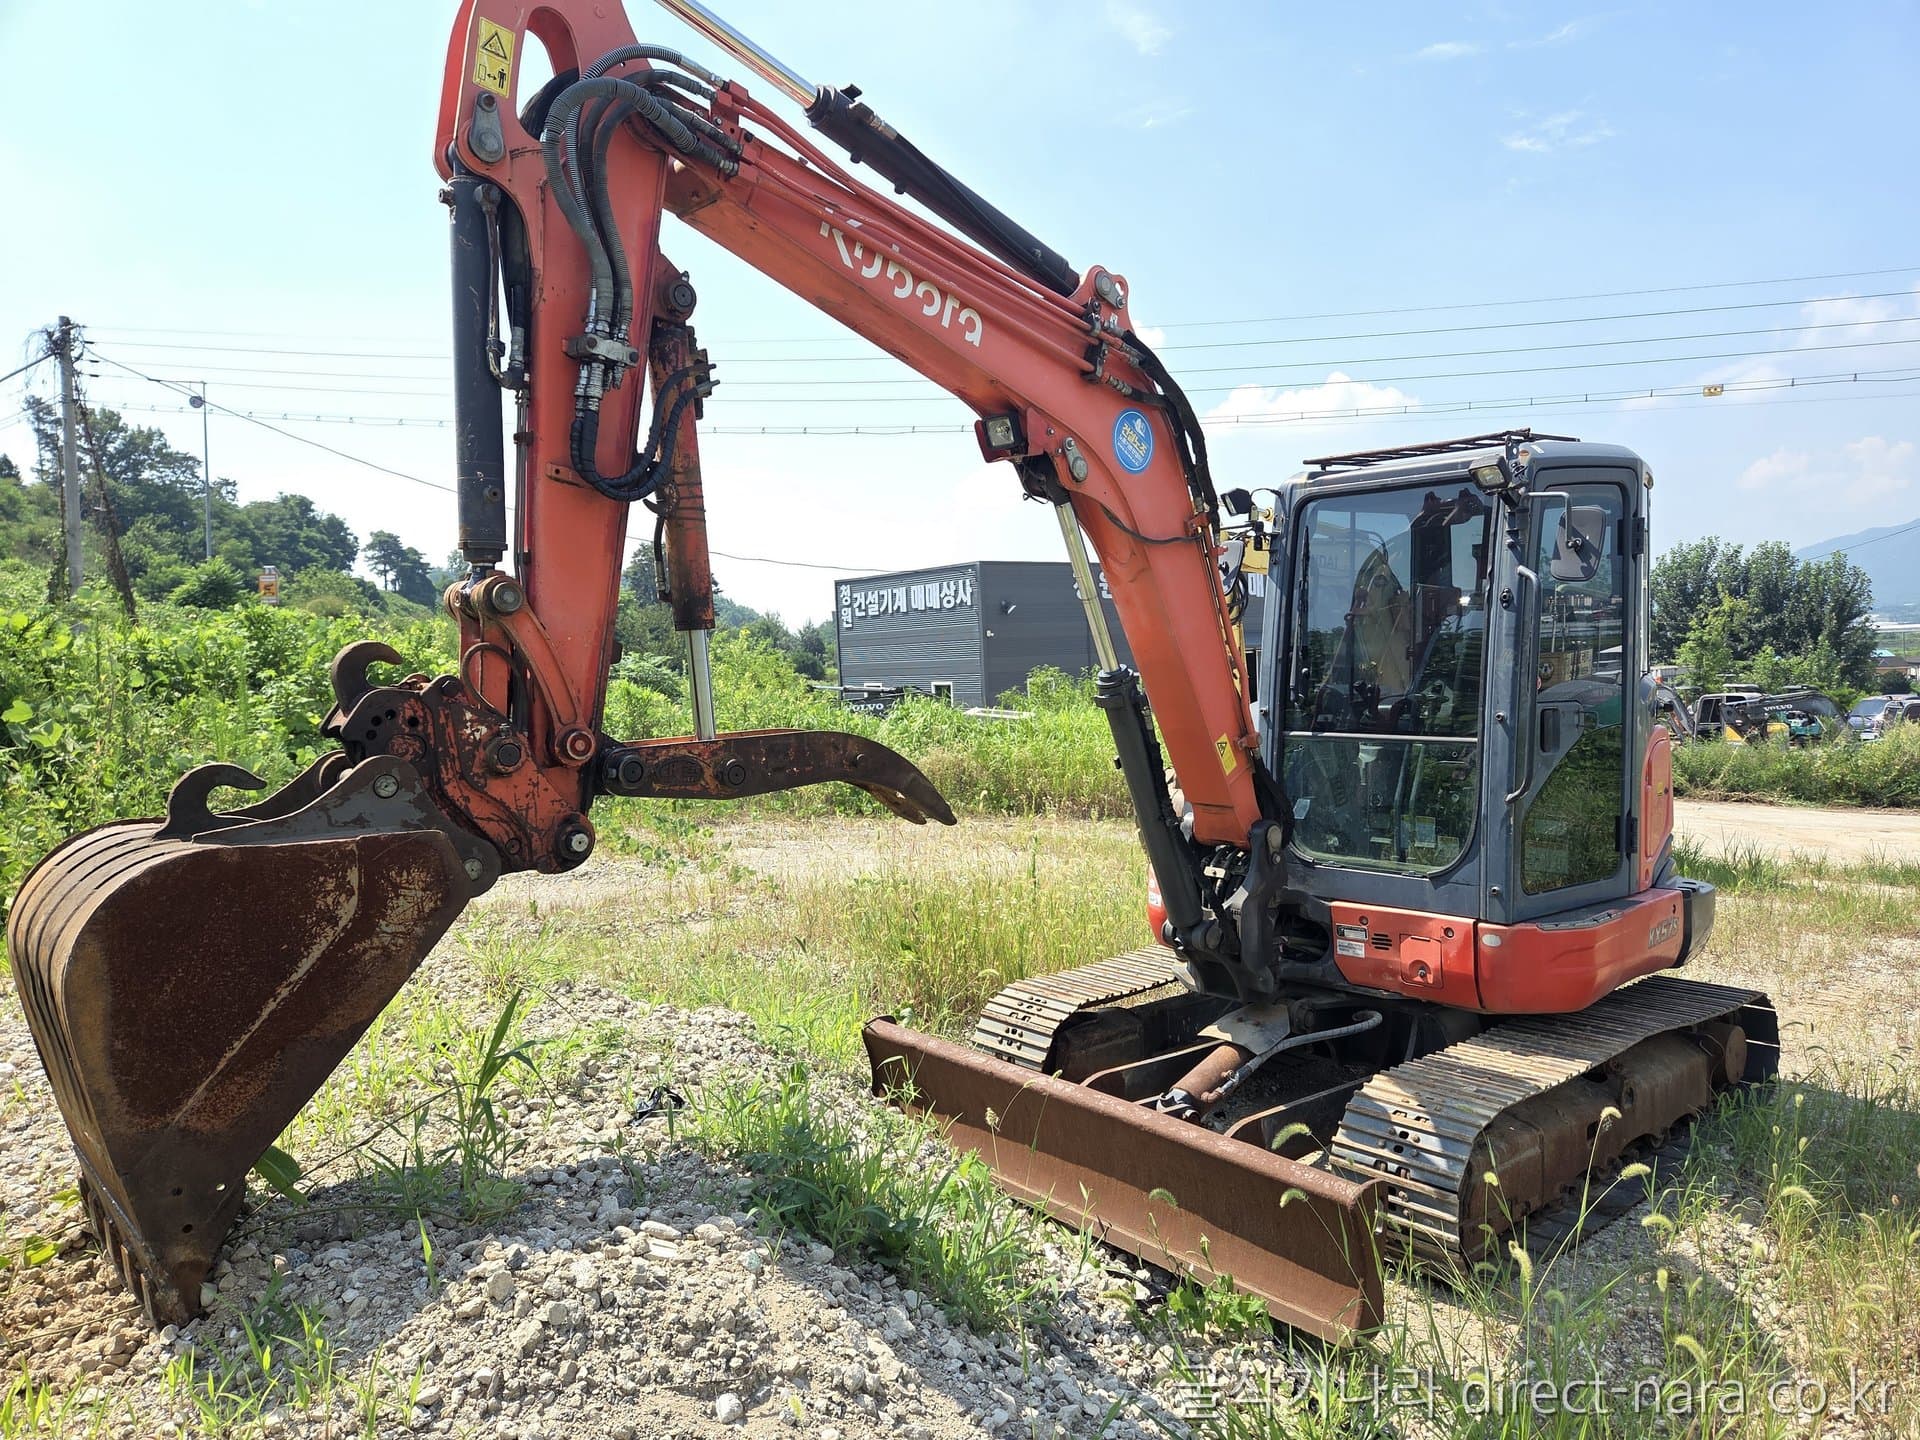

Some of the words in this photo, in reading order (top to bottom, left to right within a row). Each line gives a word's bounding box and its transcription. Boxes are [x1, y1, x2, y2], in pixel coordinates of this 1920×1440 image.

[840, 584, 852, 628] 청원
[853, 587, 907, 617] 건설기계
[911, 579, 973, 610] 매매상사
